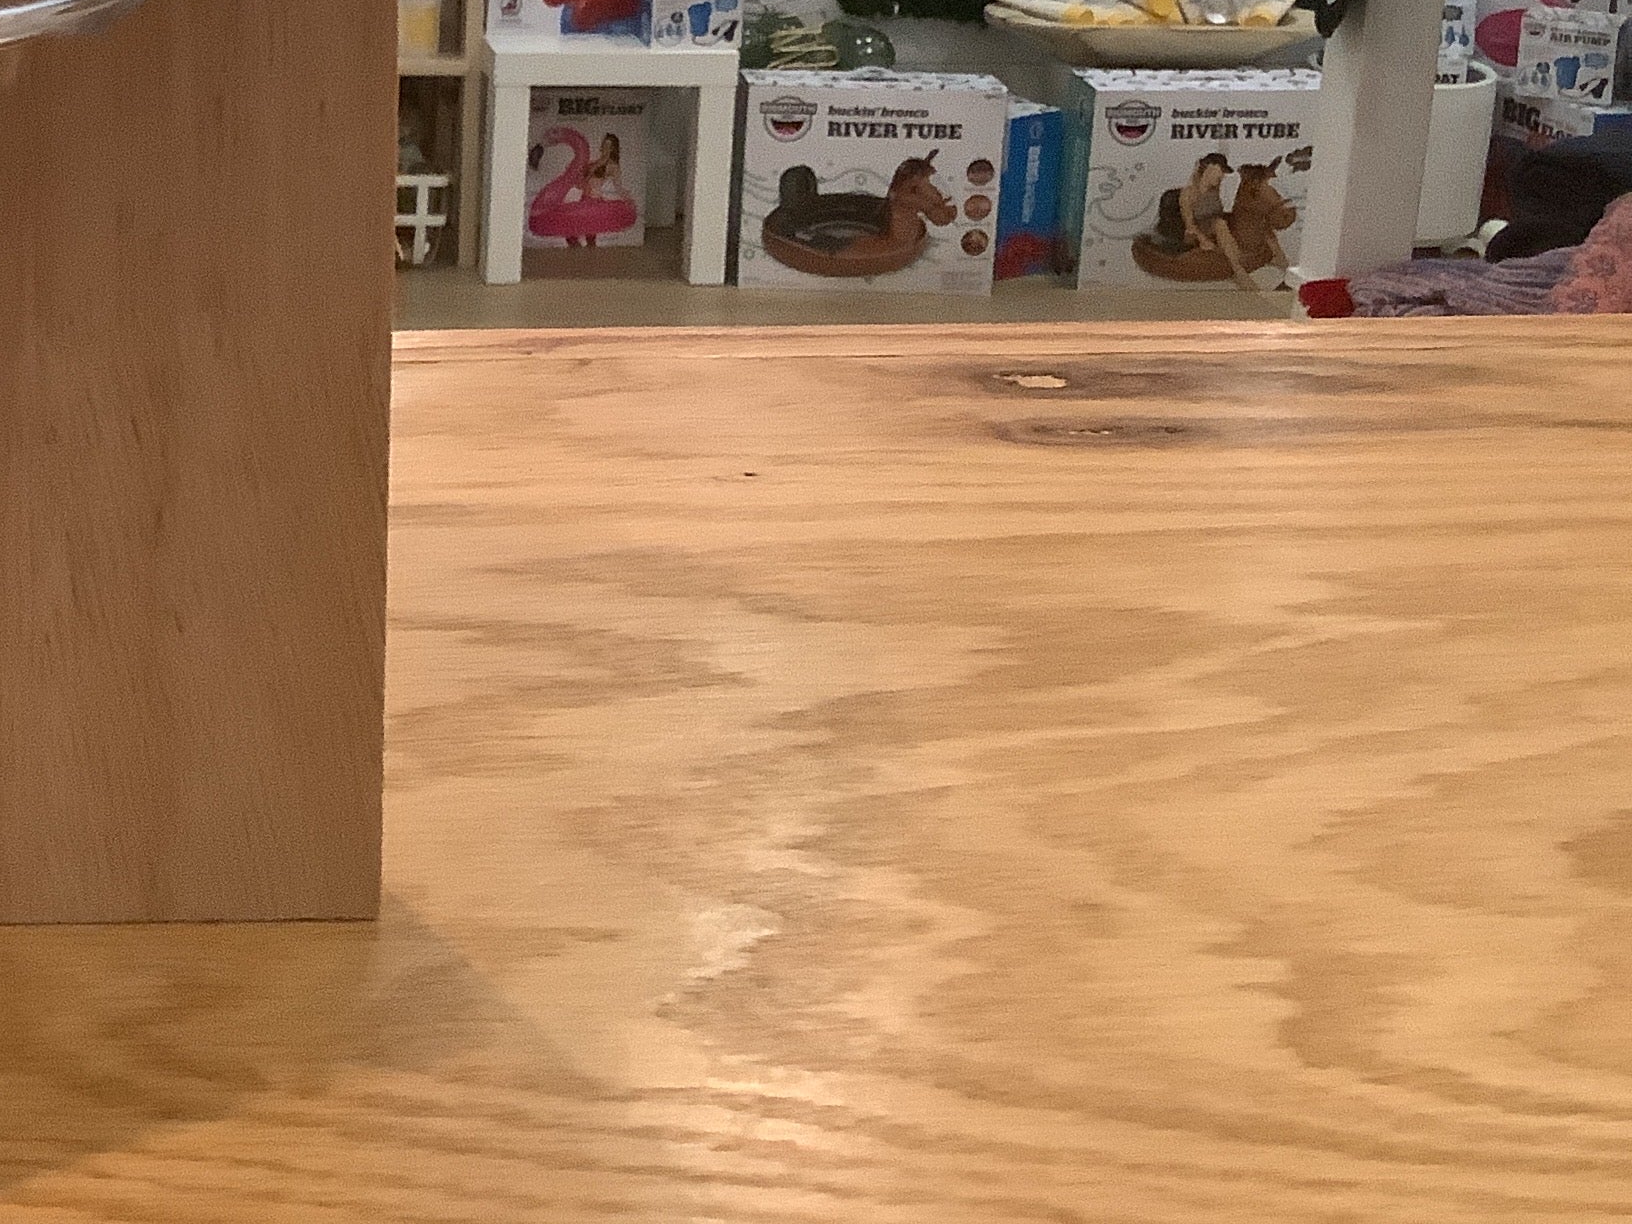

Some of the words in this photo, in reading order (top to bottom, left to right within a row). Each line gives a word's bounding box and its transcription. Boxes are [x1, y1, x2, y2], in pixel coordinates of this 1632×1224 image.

[1574, 33, 1612, 47] PUMP
[558, 97, 600, 116] BIG
[880, 106, 929, 118] bronco
[1501, 96, 1541, 133] BIG
[827, 120, 899, 139] RIVER
[903, 122, 964, 140] TUBE
[1170, 123, 1238, 140] RIVER
[1242, 122, 1301, 139] TUBE
